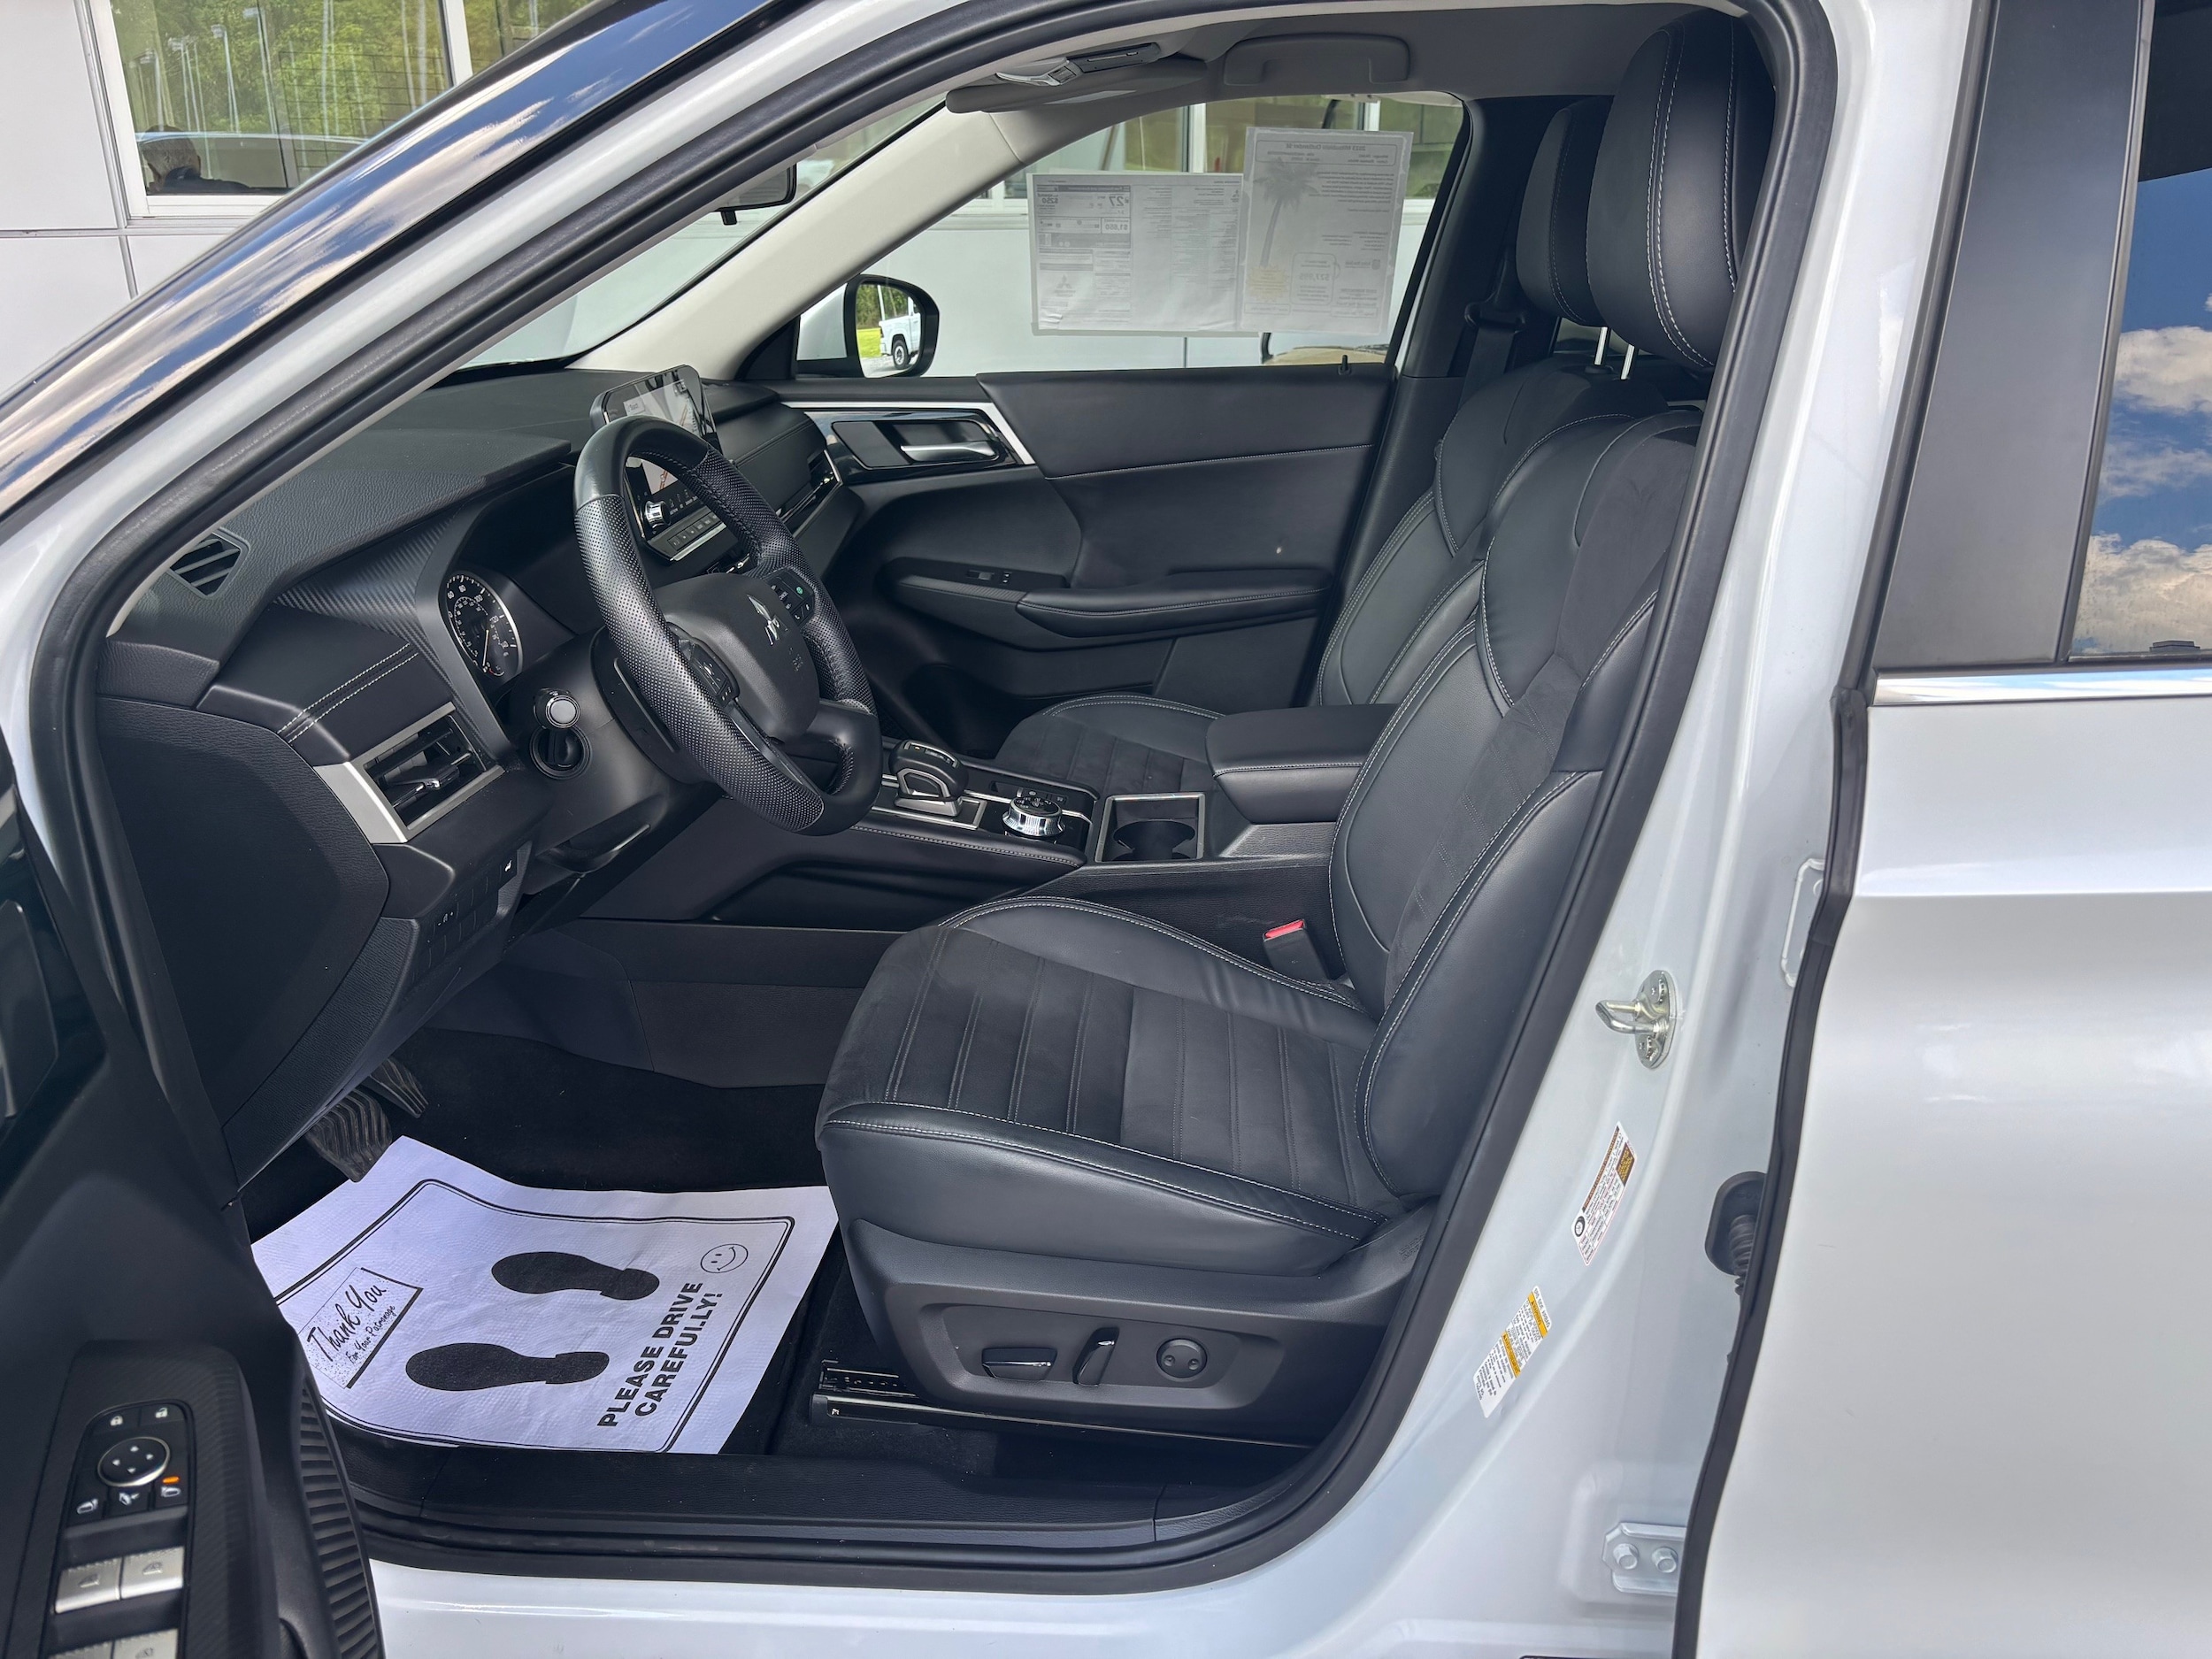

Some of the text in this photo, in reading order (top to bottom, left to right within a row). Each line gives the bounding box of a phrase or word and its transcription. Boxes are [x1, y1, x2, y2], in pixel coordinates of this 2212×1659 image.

[307, 1285, 387, 1363] Thank You
[597, 1283, 703, 1427] PLEASE DRIVE
[634, 1293, 723, 1417] CAREFULLY!
